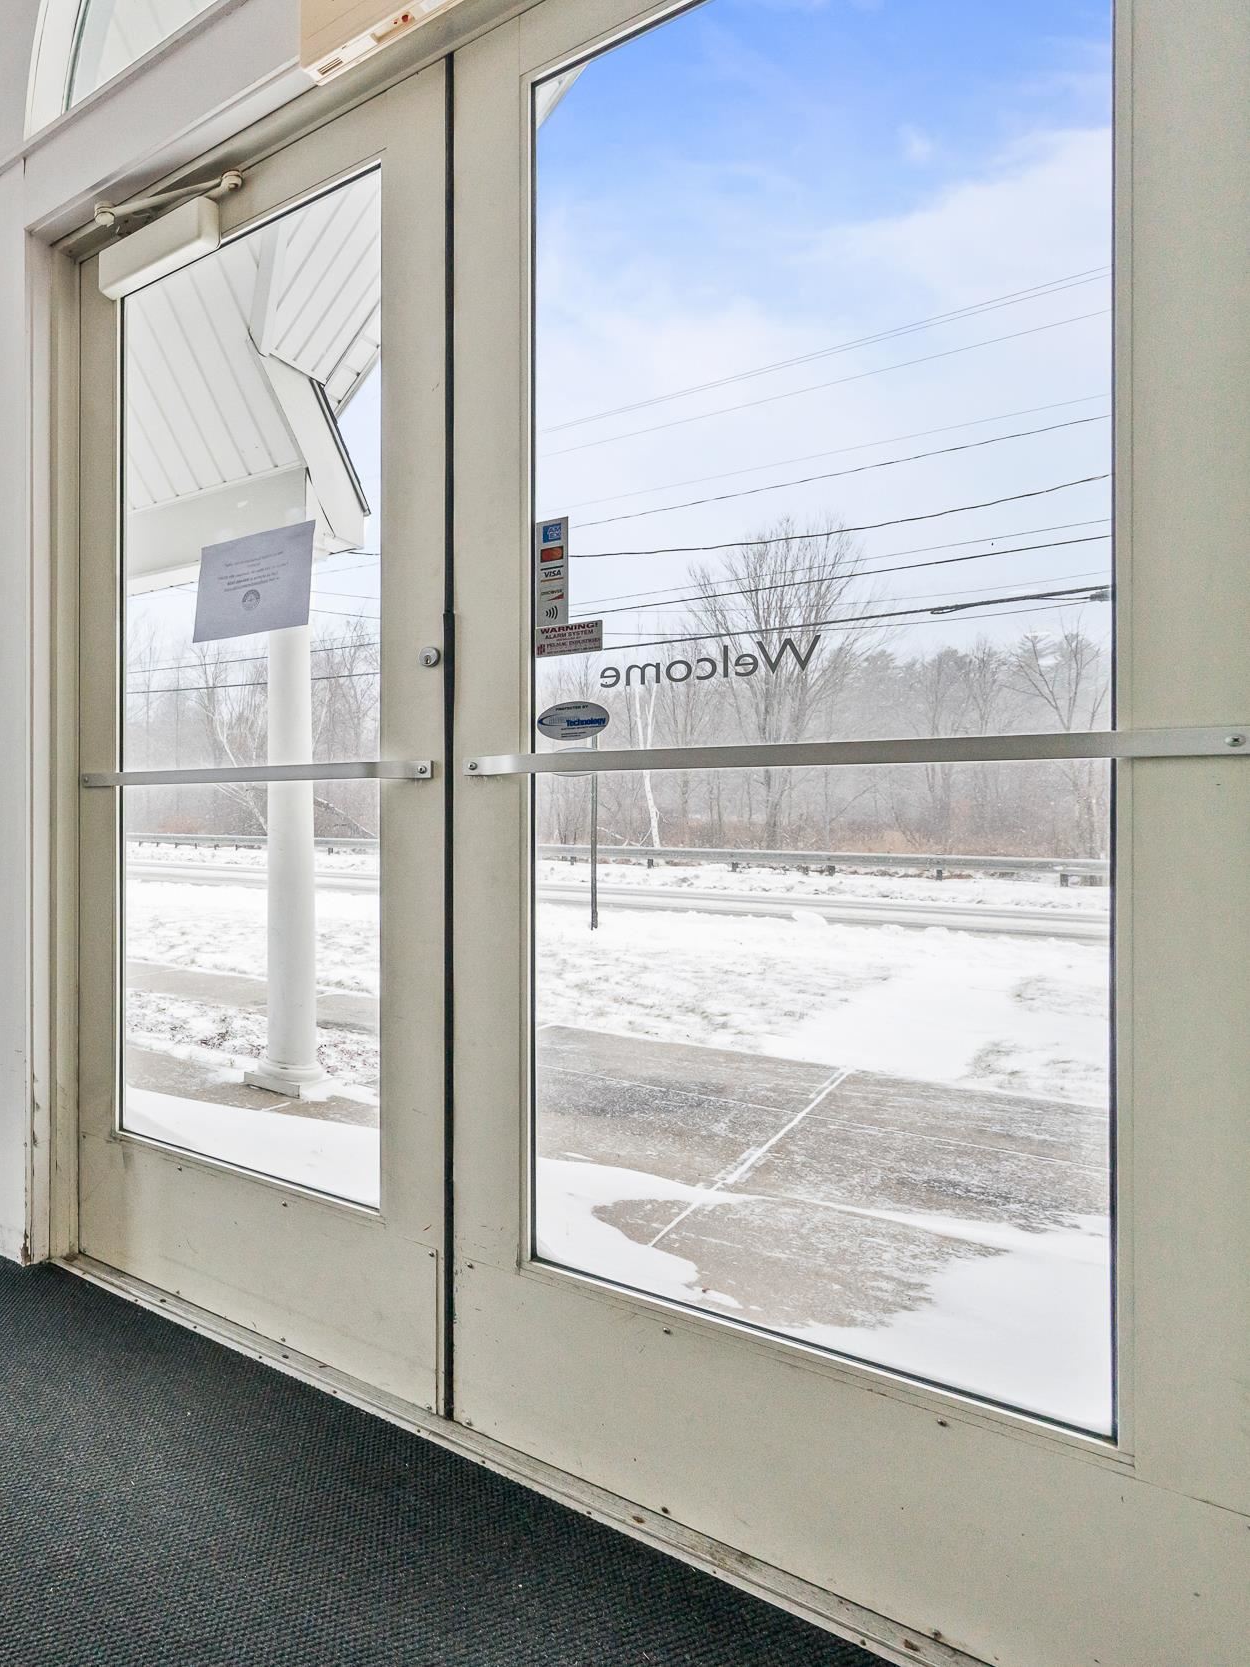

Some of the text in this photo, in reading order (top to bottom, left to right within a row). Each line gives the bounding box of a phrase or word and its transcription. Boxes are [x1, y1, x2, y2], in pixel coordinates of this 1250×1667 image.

[544, 570, 561, 578] VISA
[540, 622, 598, 635] WARNING!
[545, 631, 567, 640] ALARM
[568, 629, 594, 637] SYSTEM
[566, 717, 607, 727] Technology
